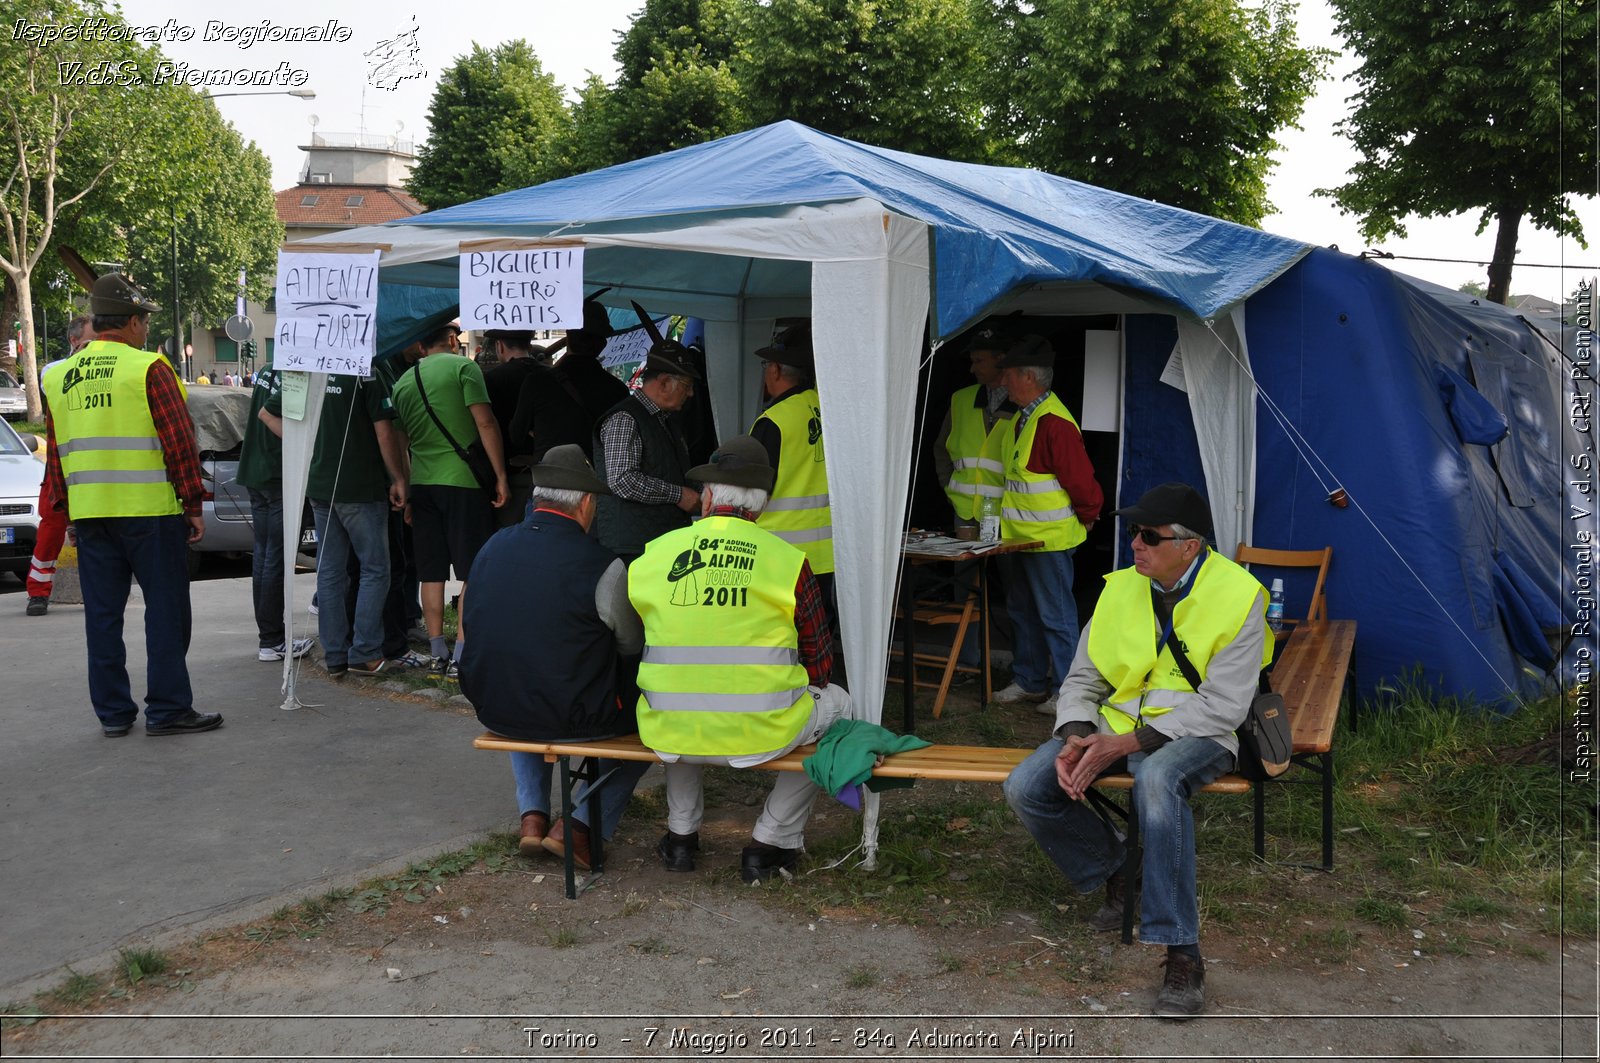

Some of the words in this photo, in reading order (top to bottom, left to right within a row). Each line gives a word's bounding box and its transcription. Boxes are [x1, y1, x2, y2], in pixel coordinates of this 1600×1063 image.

[470, 250, 572, 277] BIGLIETTI
[285, 263, 374, 301] ATTENTI
[280, 321, 297, 347] AI
[314, 313, 371, 350] FURTI
[286, 355, 305, 367] SUL
[85, 368, 114, 380] ALPINI
[84, 379, 112, 394] TORINO
[84, 393, 112, 410] 2011
[724, 545, 757, 556] NAZIONALE
[725, 538, 758, 550] ADUNATA
[708, 553, 755, 571] ALPINI
[705, 569, 752, 586] TORINO
[702, 586, 748, 607] 2011
